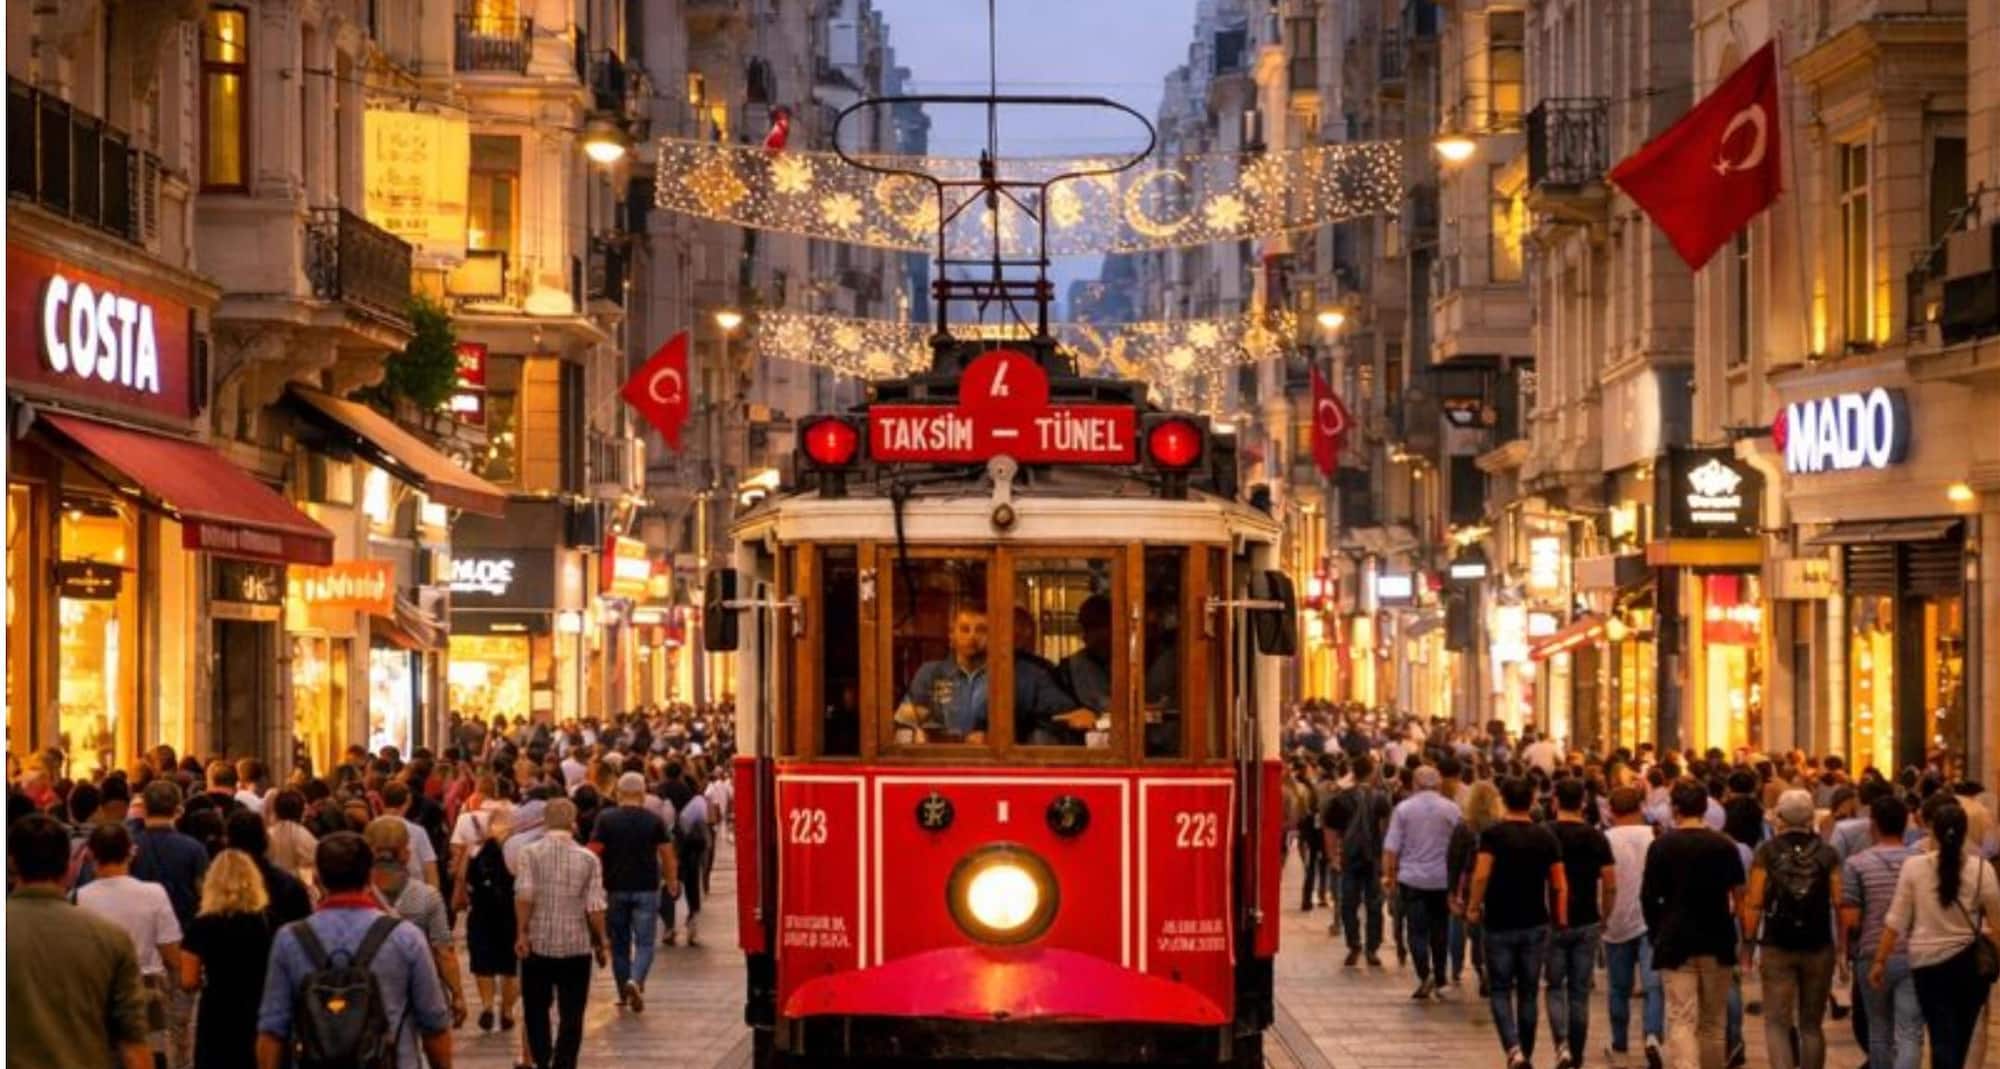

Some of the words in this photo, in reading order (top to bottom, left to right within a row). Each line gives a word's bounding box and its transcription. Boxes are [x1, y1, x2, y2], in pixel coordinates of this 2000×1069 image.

[44, 273, 159, 394] COSTA
[1034, 411, 1123, 451] TÜNEL
[1787, 387, 1893, 473] MADO
[789, 808, 828, 844] 223
[1175, 811, 1218, 848] 223
